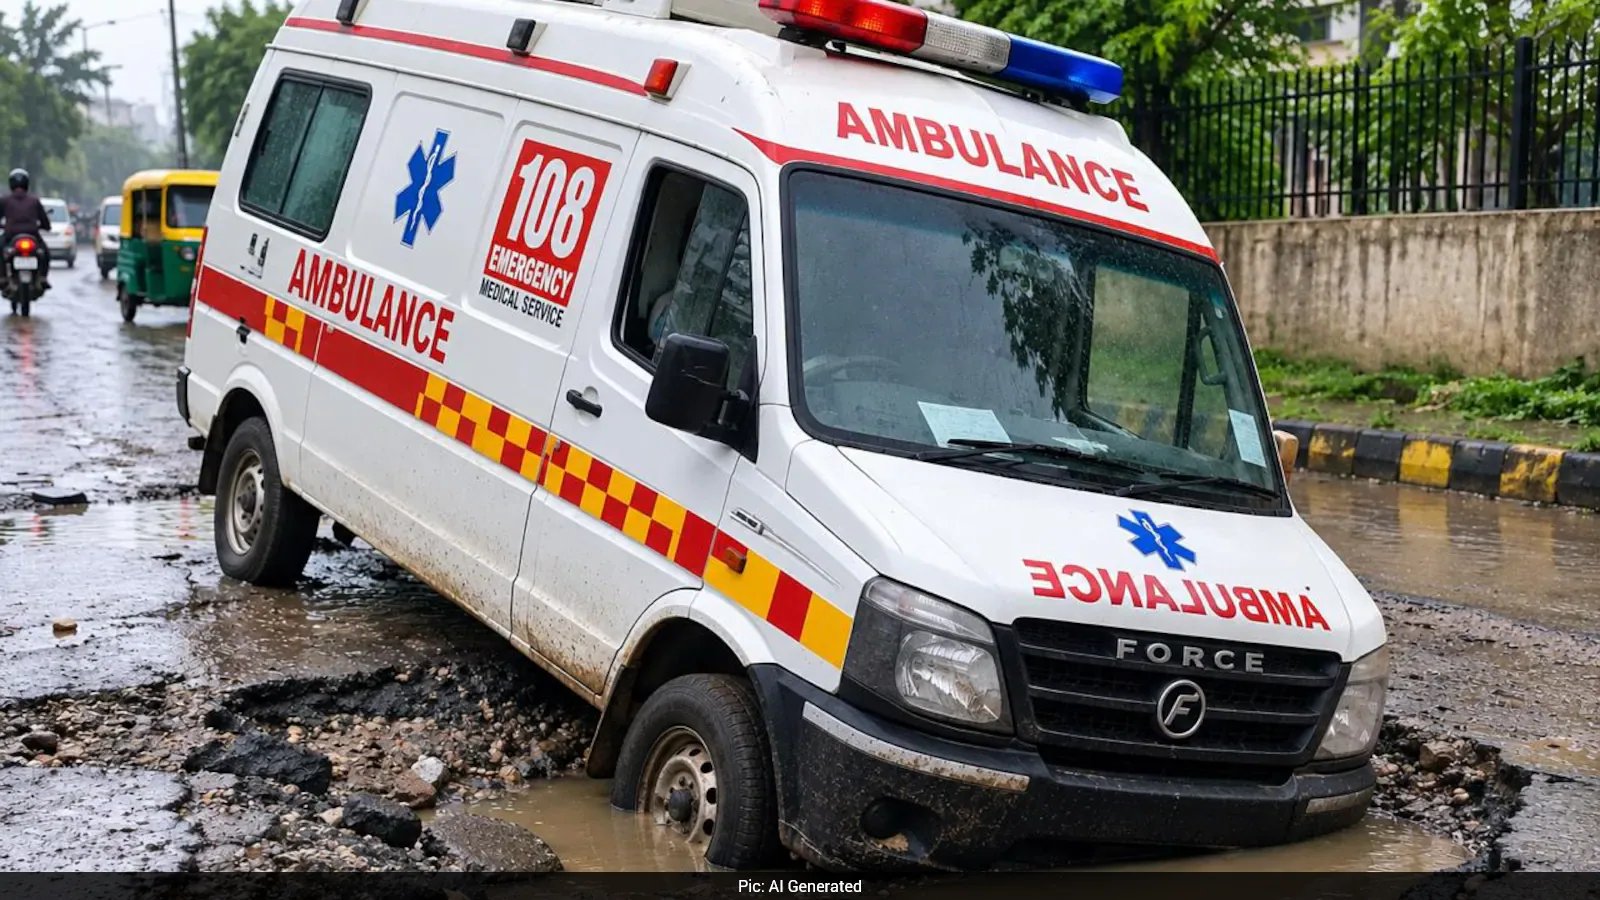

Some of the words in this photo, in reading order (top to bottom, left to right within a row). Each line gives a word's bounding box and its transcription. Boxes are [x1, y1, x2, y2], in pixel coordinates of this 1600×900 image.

[837, 101, 1150, 213] AMBULANCE
[506, 153, 596, 259] 108
[287, 248, 455, 365] AMBULANCE
[479, 277, 519, 310] MEDICAL
[521, 295, 564, 328] SERVICE
[488, 244, 574, 299] EMERGENCY
[1116, 637, 1265, 674] FORCE
